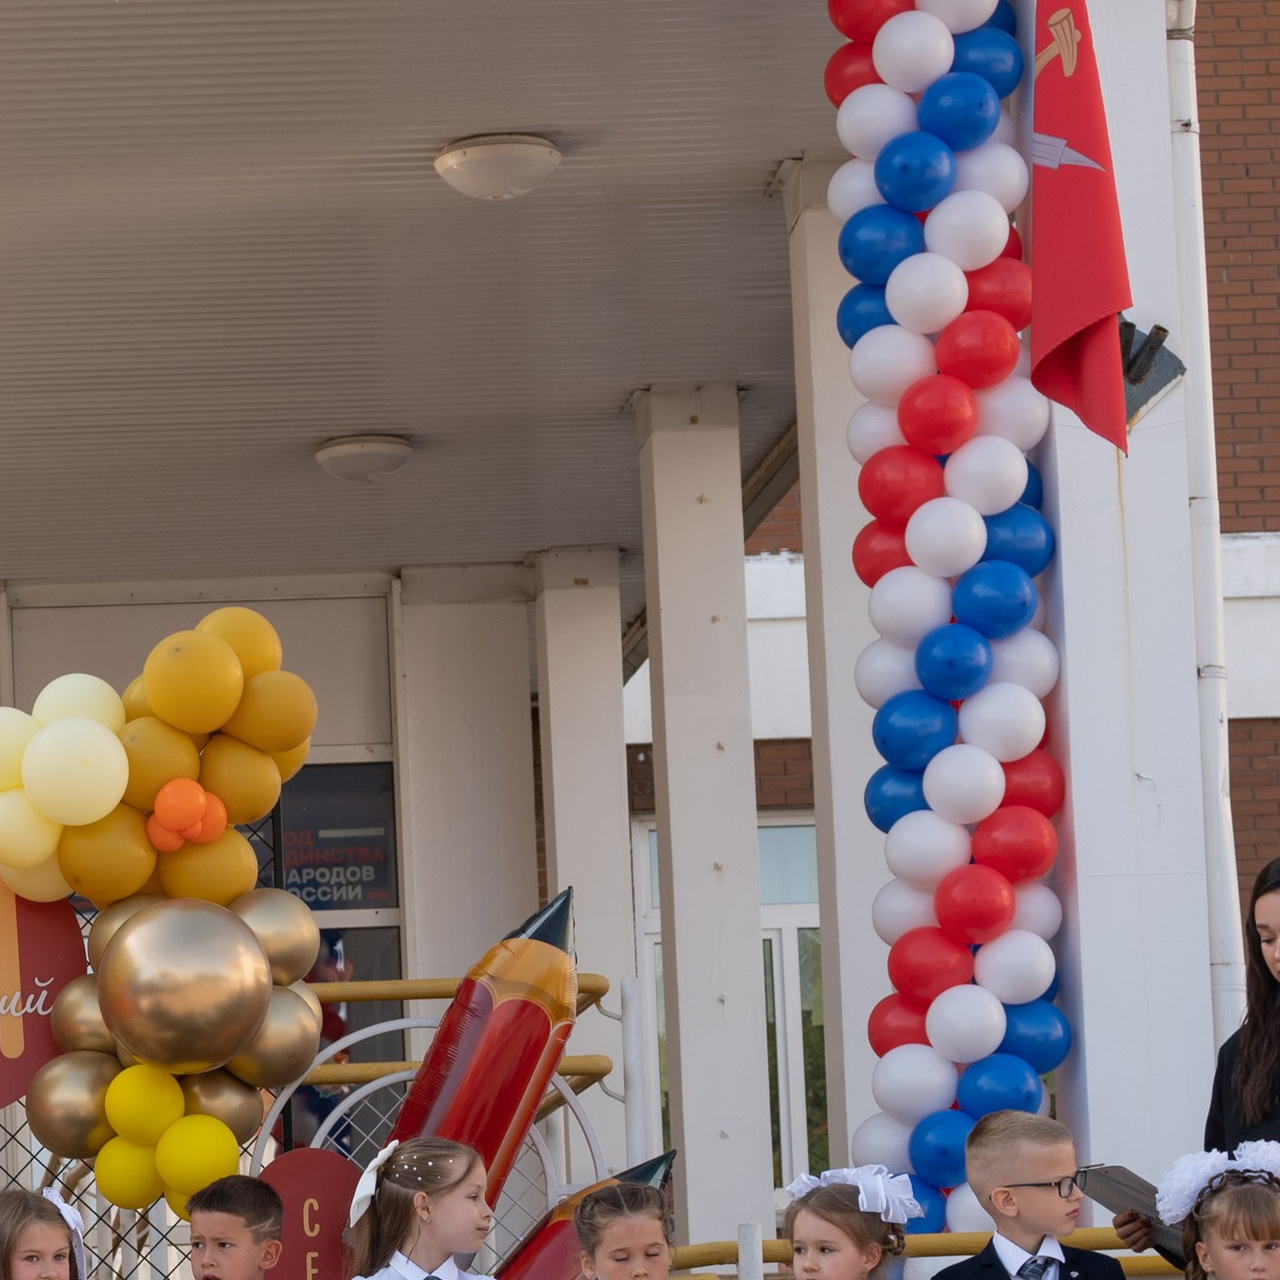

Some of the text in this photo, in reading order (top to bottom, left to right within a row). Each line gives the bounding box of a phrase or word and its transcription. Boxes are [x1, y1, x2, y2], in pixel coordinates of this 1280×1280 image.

[282, 828, 314, 848] ОД
[283, 846, 389, 868] ДИНСТВА
[286, 865, 376, 885] АРОДОВ
[287, 884, 363, 902] ОССИИ
